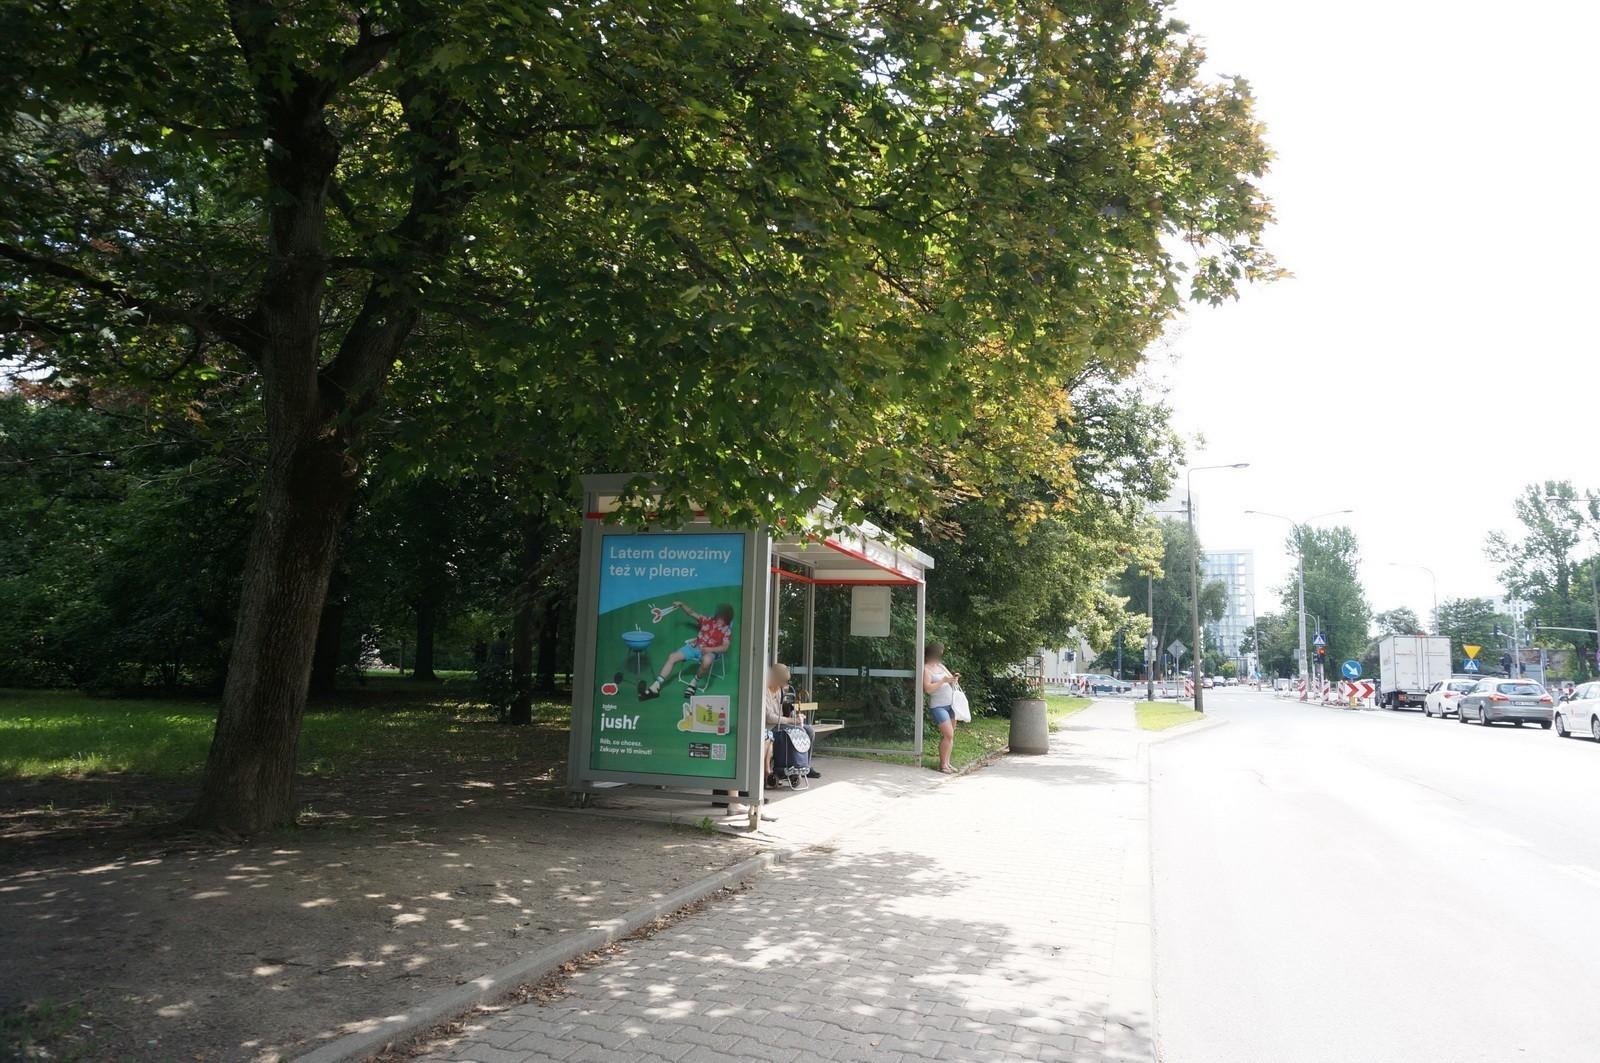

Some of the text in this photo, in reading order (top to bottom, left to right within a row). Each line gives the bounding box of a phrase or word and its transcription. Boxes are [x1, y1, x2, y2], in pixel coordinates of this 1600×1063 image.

[610, 546, 731, 564] Latem dowozimy
[609, 564, 698, 580] też w plener.
[600, 713, 640, 731] jush!
[600, 746, 619, 754] Zakupy
